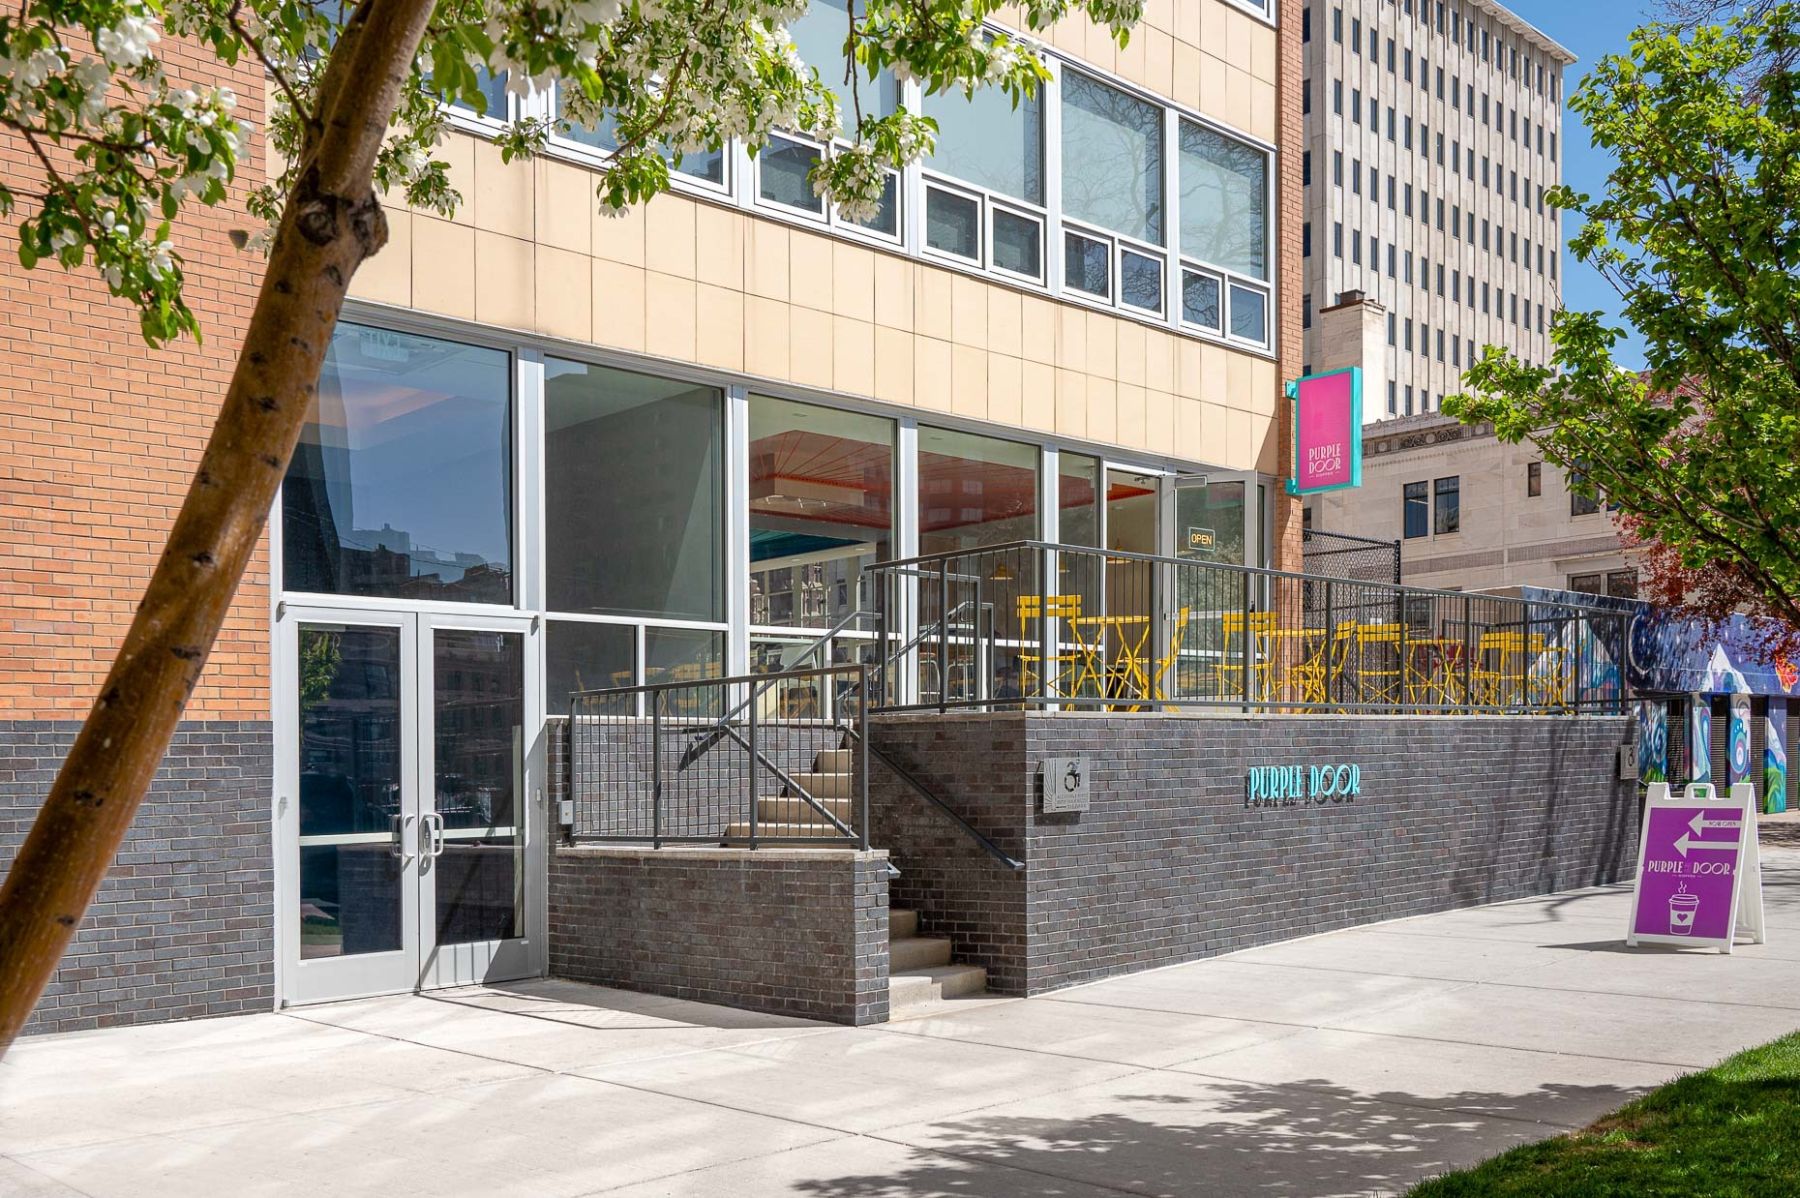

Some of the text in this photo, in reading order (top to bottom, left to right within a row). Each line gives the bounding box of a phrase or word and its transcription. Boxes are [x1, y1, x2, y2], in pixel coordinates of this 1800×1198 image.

[1309, 443, 1341, 461] PURPLE
[1309, 457, 1341, 474] DOOR
[1191, 533, 1212, 545] OPEN
[1249, 763, 1360, 800] PURPLE DOOR
[1648, 860, 1730, 875] PURPLE DOOR
